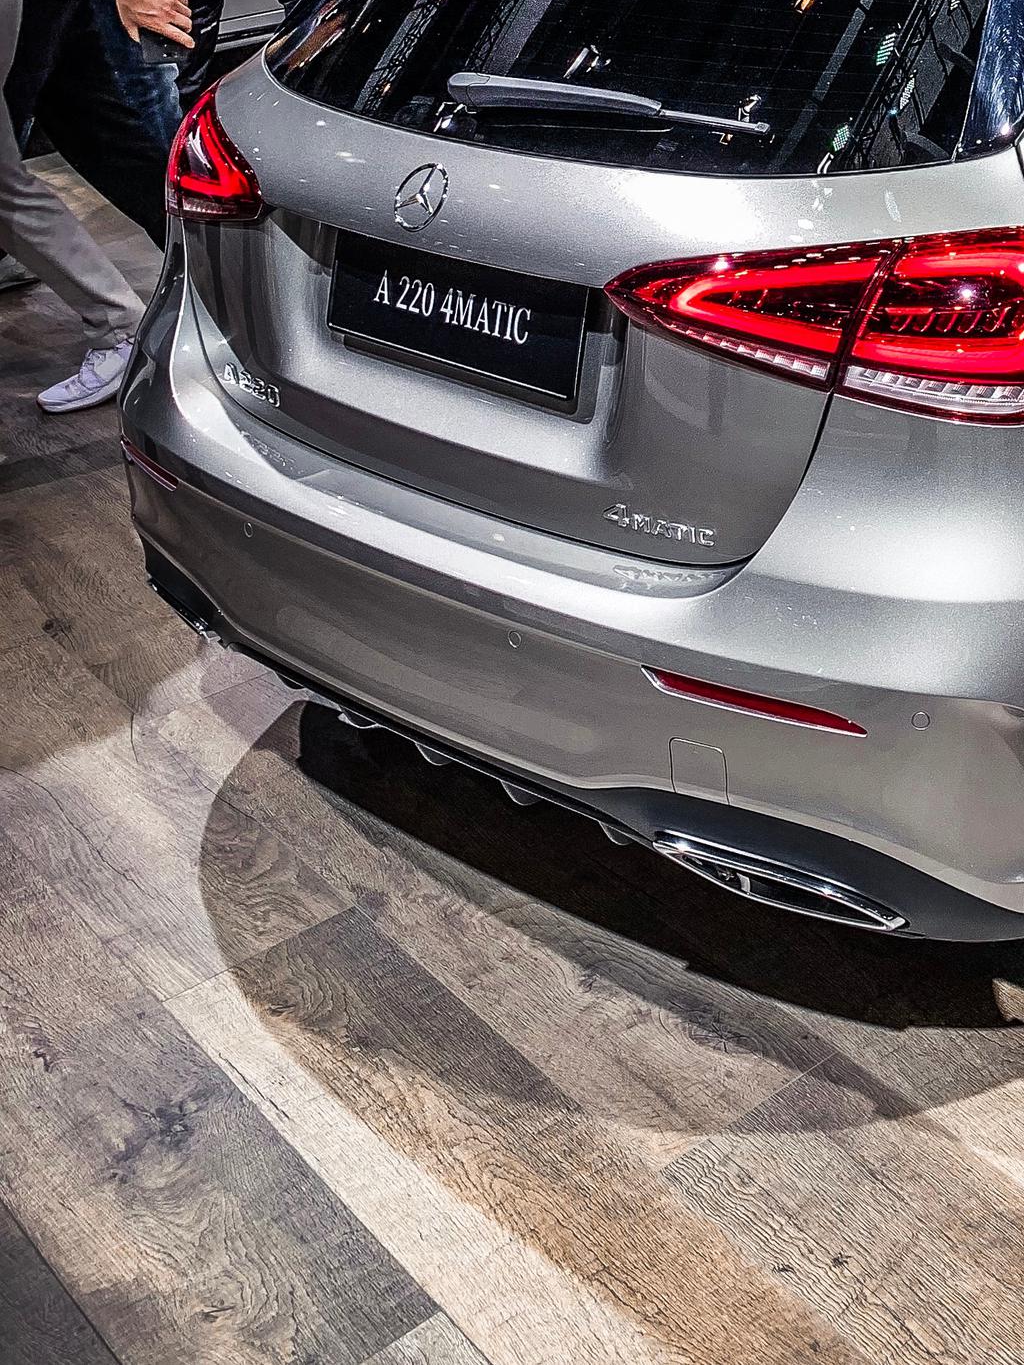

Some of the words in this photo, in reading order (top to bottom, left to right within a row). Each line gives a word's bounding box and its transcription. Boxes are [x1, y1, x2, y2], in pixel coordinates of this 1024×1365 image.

[373, 269, 391, 305] A
[396, 275, 435, 317] 220
[440, 288, 532, 345] 4MATIC
[602, 503, 715, 546] 4MATIC
